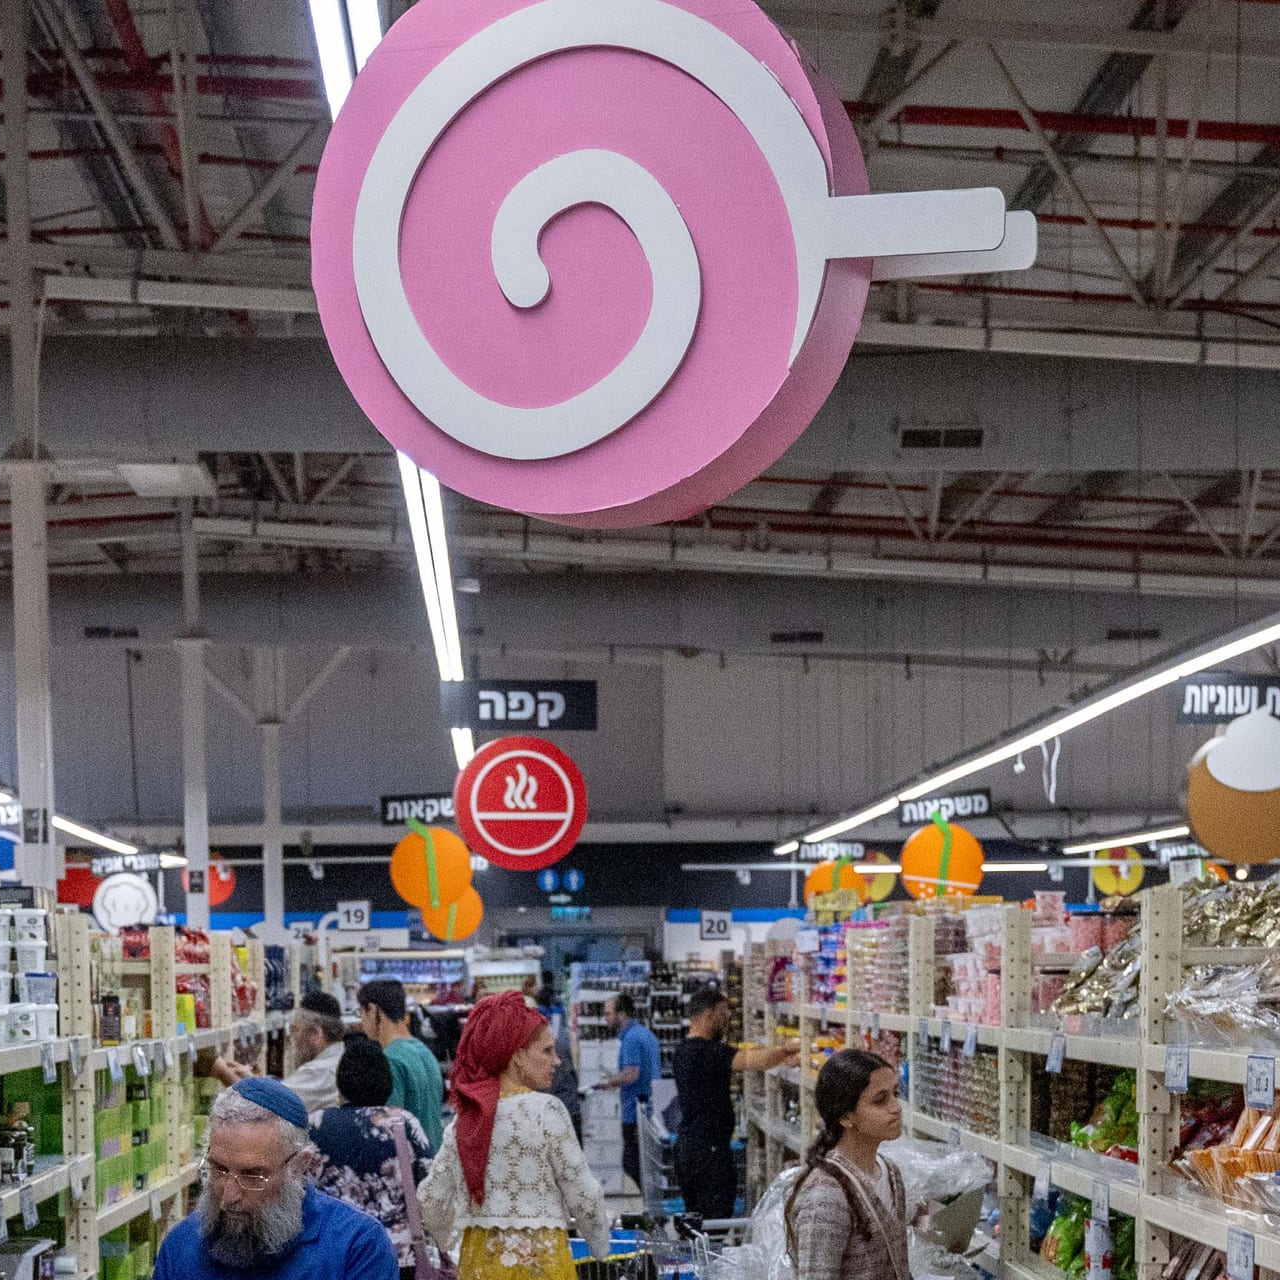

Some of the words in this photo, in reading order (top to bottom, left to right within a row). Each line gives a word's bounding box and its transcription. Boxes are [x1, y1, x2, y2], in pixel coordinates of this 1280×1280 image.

[477, 690, 566, 730] קפה
[1183, 685, 1258, 715] ועוגיות
[386, 798, 455, 822] שקאות
[902, 794, 989, 822] משקאות
[343, 908, 365, 924] 19
[703, 918, 727, 935] 20
